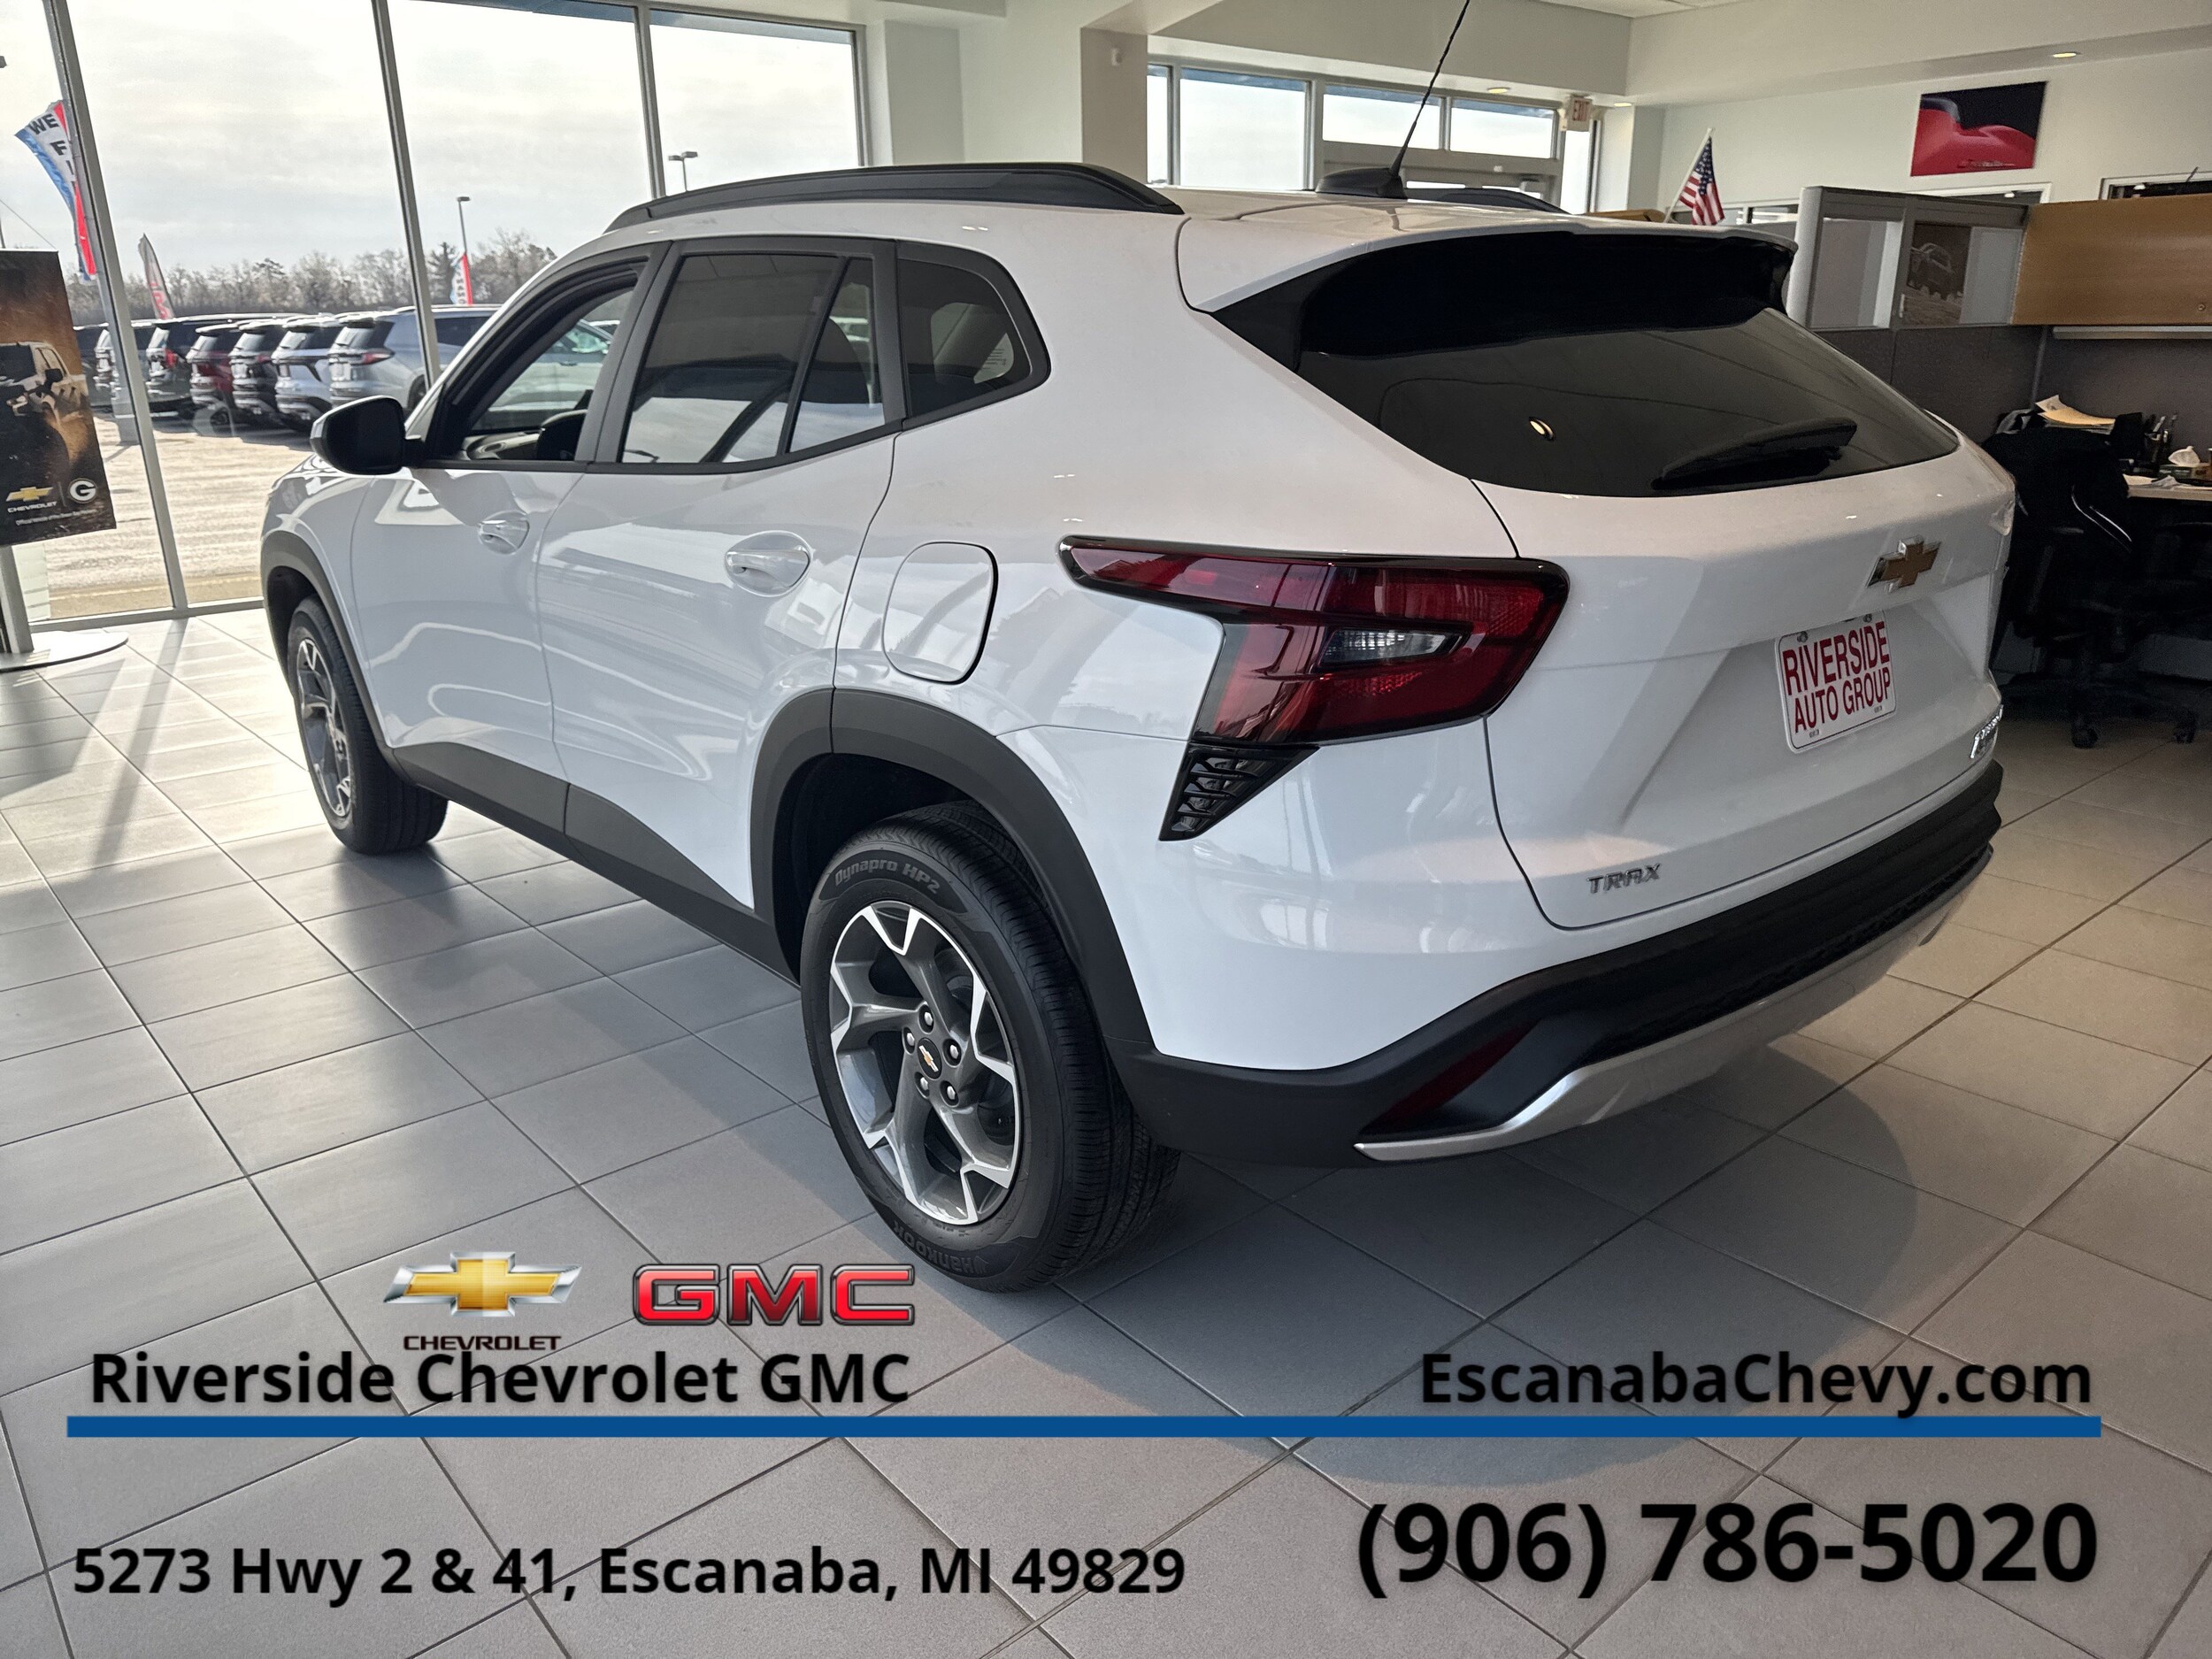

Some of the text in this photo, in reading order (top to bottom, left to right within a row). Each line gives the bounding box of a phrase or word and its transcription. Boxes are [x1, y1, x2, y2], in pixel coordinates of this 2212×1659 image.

[28, 113, 59, 134] WE
[7, 501, 58, 513] CHEVROLET
[1782, 620, 1890, 695] RIVERSIDE
[1794, 666, 1891, 733] AUTO GROUP
[834, 859, 941, 895] Dynapro HP2
[1586, 863, 1661, 895] TRAX
